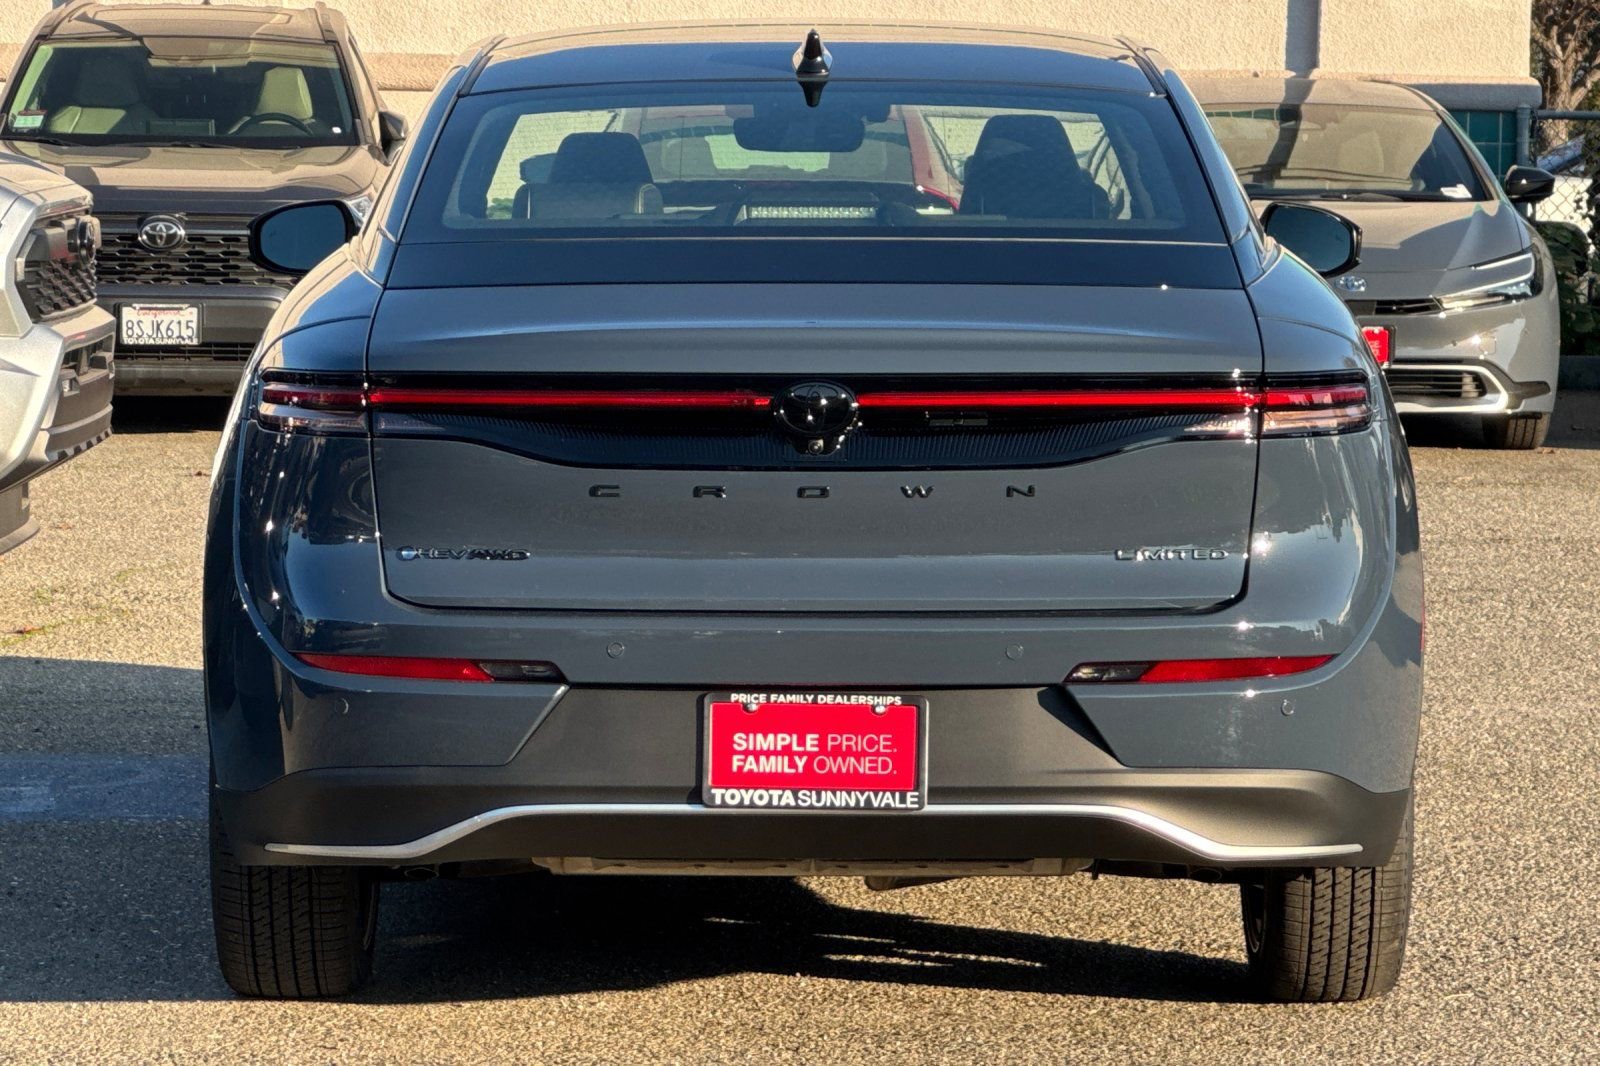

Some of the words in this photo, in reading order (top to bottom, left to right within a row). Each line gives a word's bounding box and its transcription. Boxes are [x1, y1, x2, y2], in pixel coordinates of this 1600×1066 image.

[126, 320, 195, 337] 8SJK615
[124, 337, 154, 345] TOYOTA
[588, 485, 1036, 499] CROWN
[1115, 549, 1229, 561] LIMITED
[730, 693, 767, 704] PRICE
[770, 694, 814, 704] FAMILY
[817, 694, 902, 706] DEALERSHIPS
[732, 732, 820, 752] SIMPLE
[827, 734, 897, 753] PRICE.
[732, 755, 808, 773] FAMILY
[813, 755, 897, 775] OWNED.
[711, 788, 796, 806] TOYOTA
[797, 789, 919, 808] SUNNYVALE
